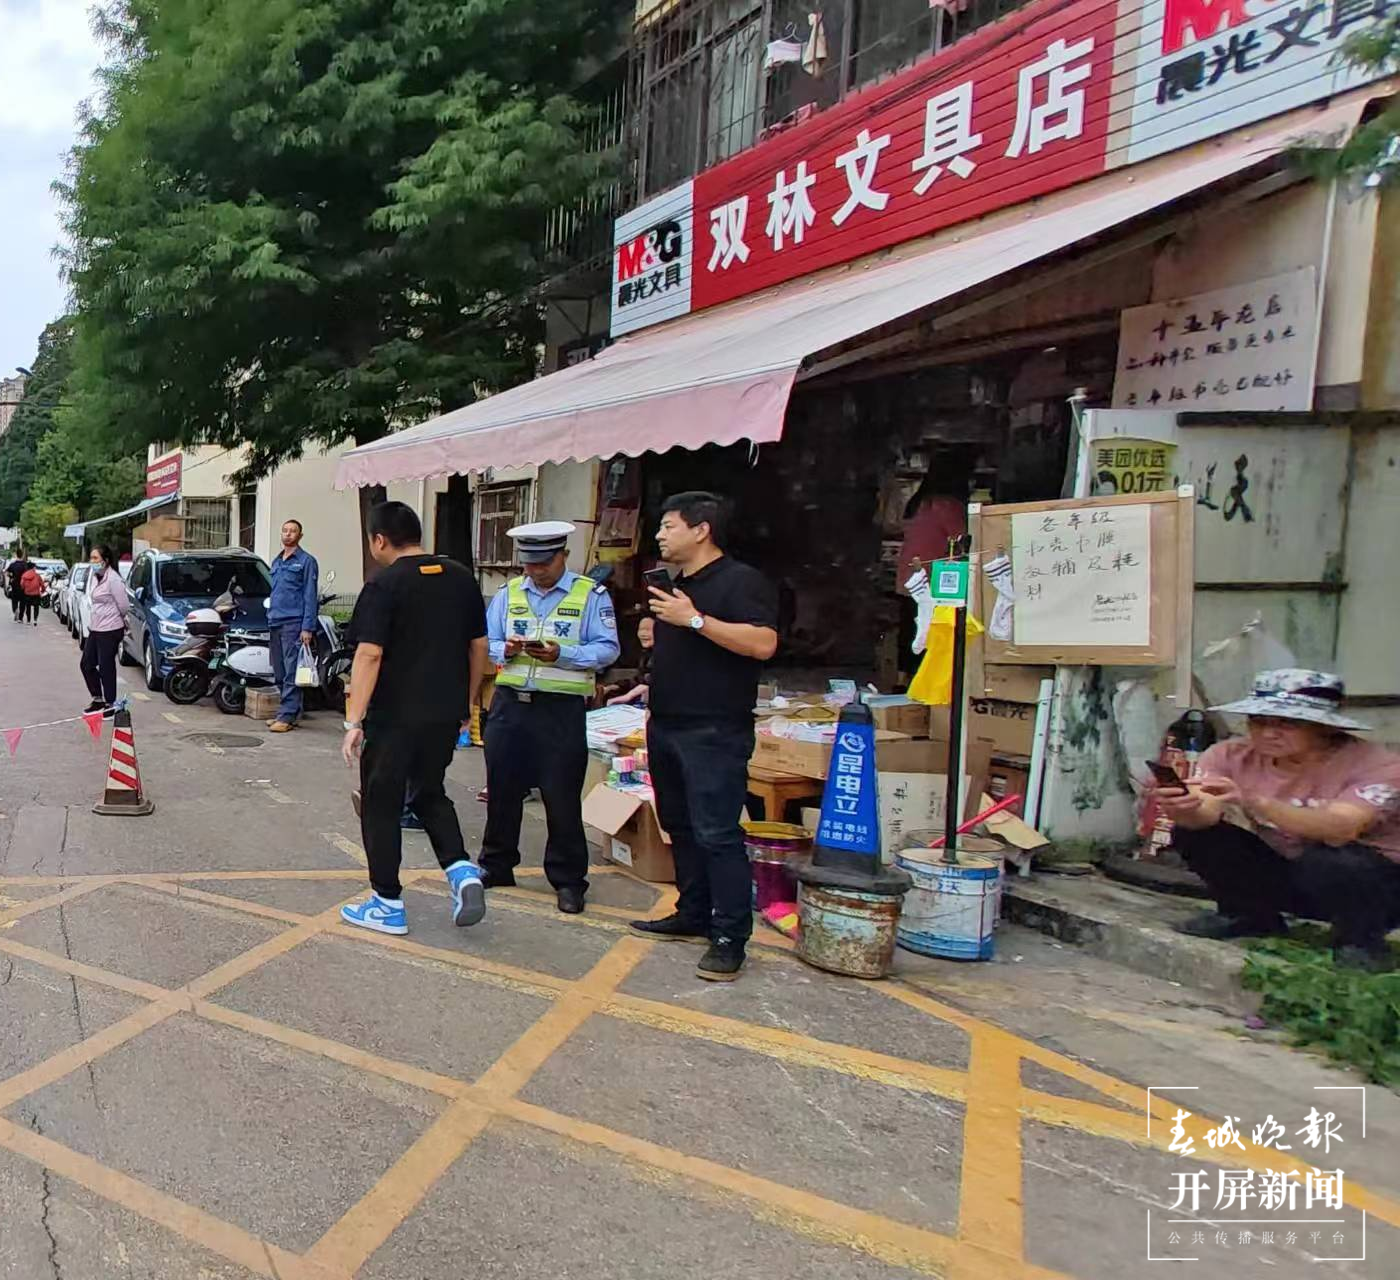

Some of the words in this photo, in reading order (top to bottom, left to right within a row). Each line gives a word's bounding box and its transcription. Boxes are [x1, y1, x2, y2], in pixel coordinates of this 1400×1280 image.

[707, 37, 1095, 272] 双林文具店
[618, 220, 683, 283] M&G
[618, 263, 681, 308] 晨光文具
[1152, 294, 1284, 342] 十五年老店
[1096, 448, 1166, 468] 美团优选
[1040, 511, 1115, 532] 各年级
[834, 753, 863, 815] 昆电立
